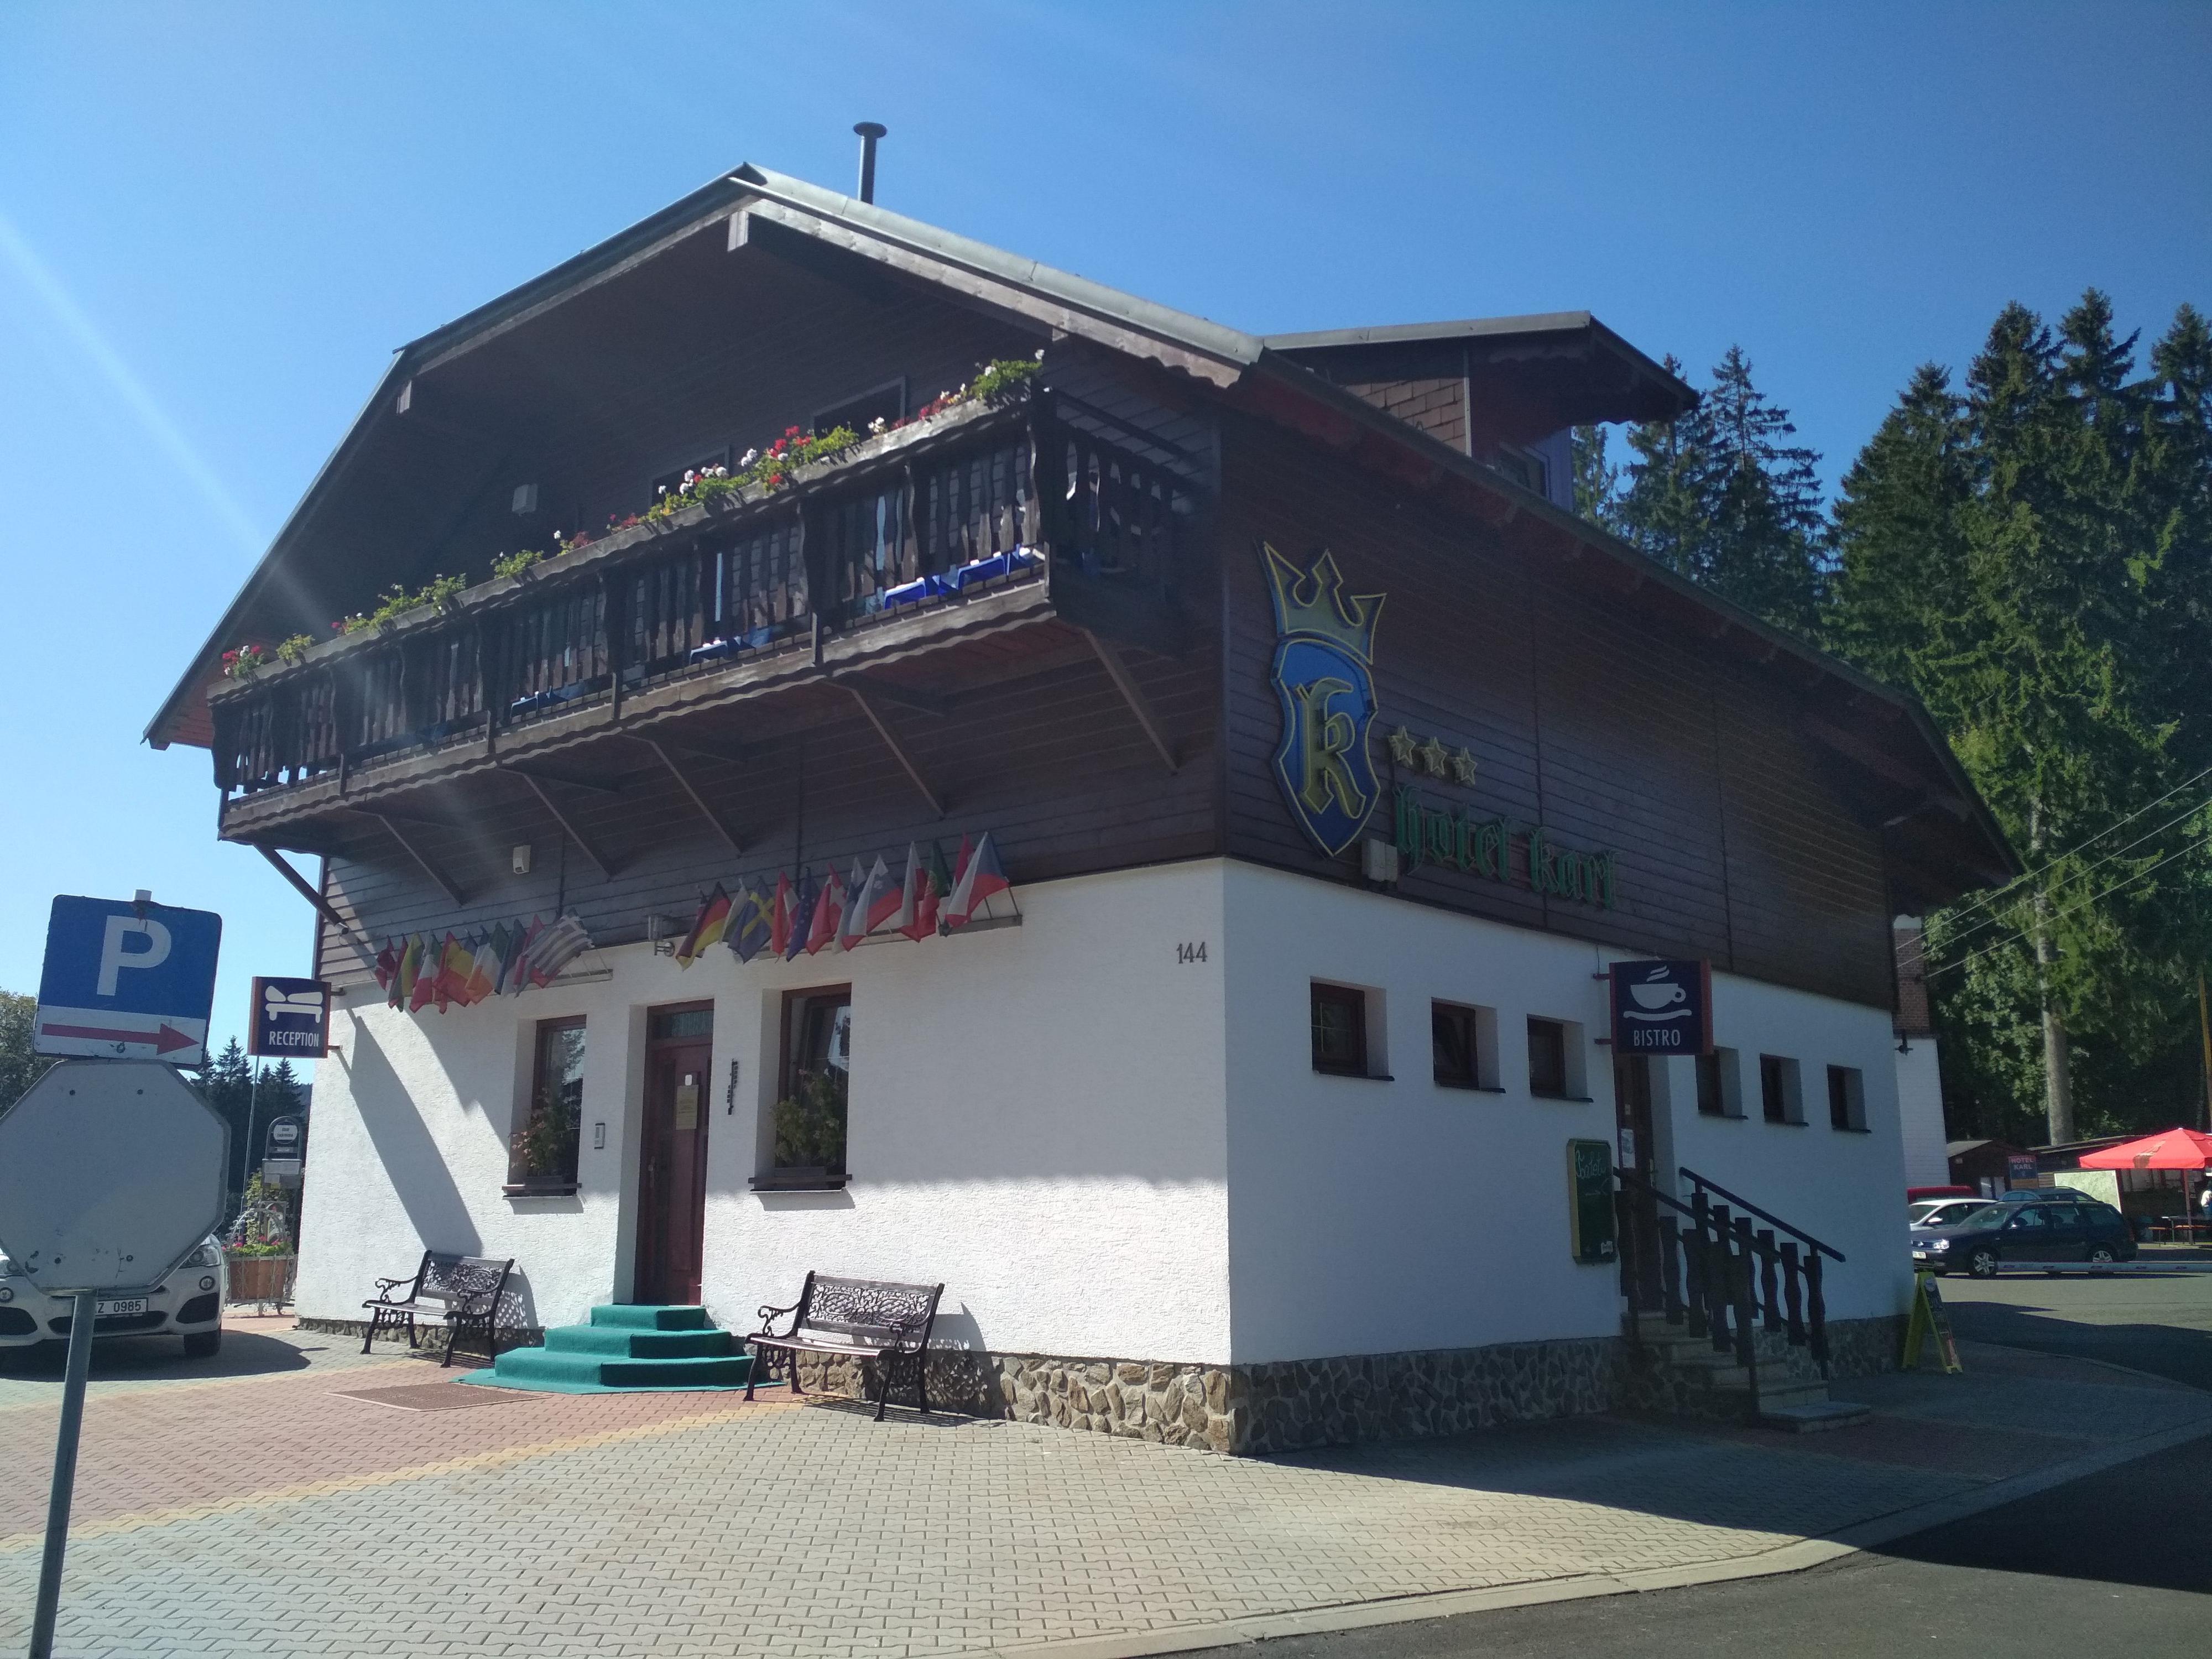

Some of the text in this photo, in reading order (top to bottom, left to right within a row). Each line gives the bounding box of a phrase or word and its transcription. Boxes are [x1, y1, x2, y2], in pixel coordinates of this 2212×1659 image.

[96, 915, 171, 996] P
[1176, 942, 1208, 964] 144
[269, 1030, 319, 1048] RECEPTION
[1633, 1029, 1681, 1047] BISTRO
[113, 1301, 142, 1312] 0985
